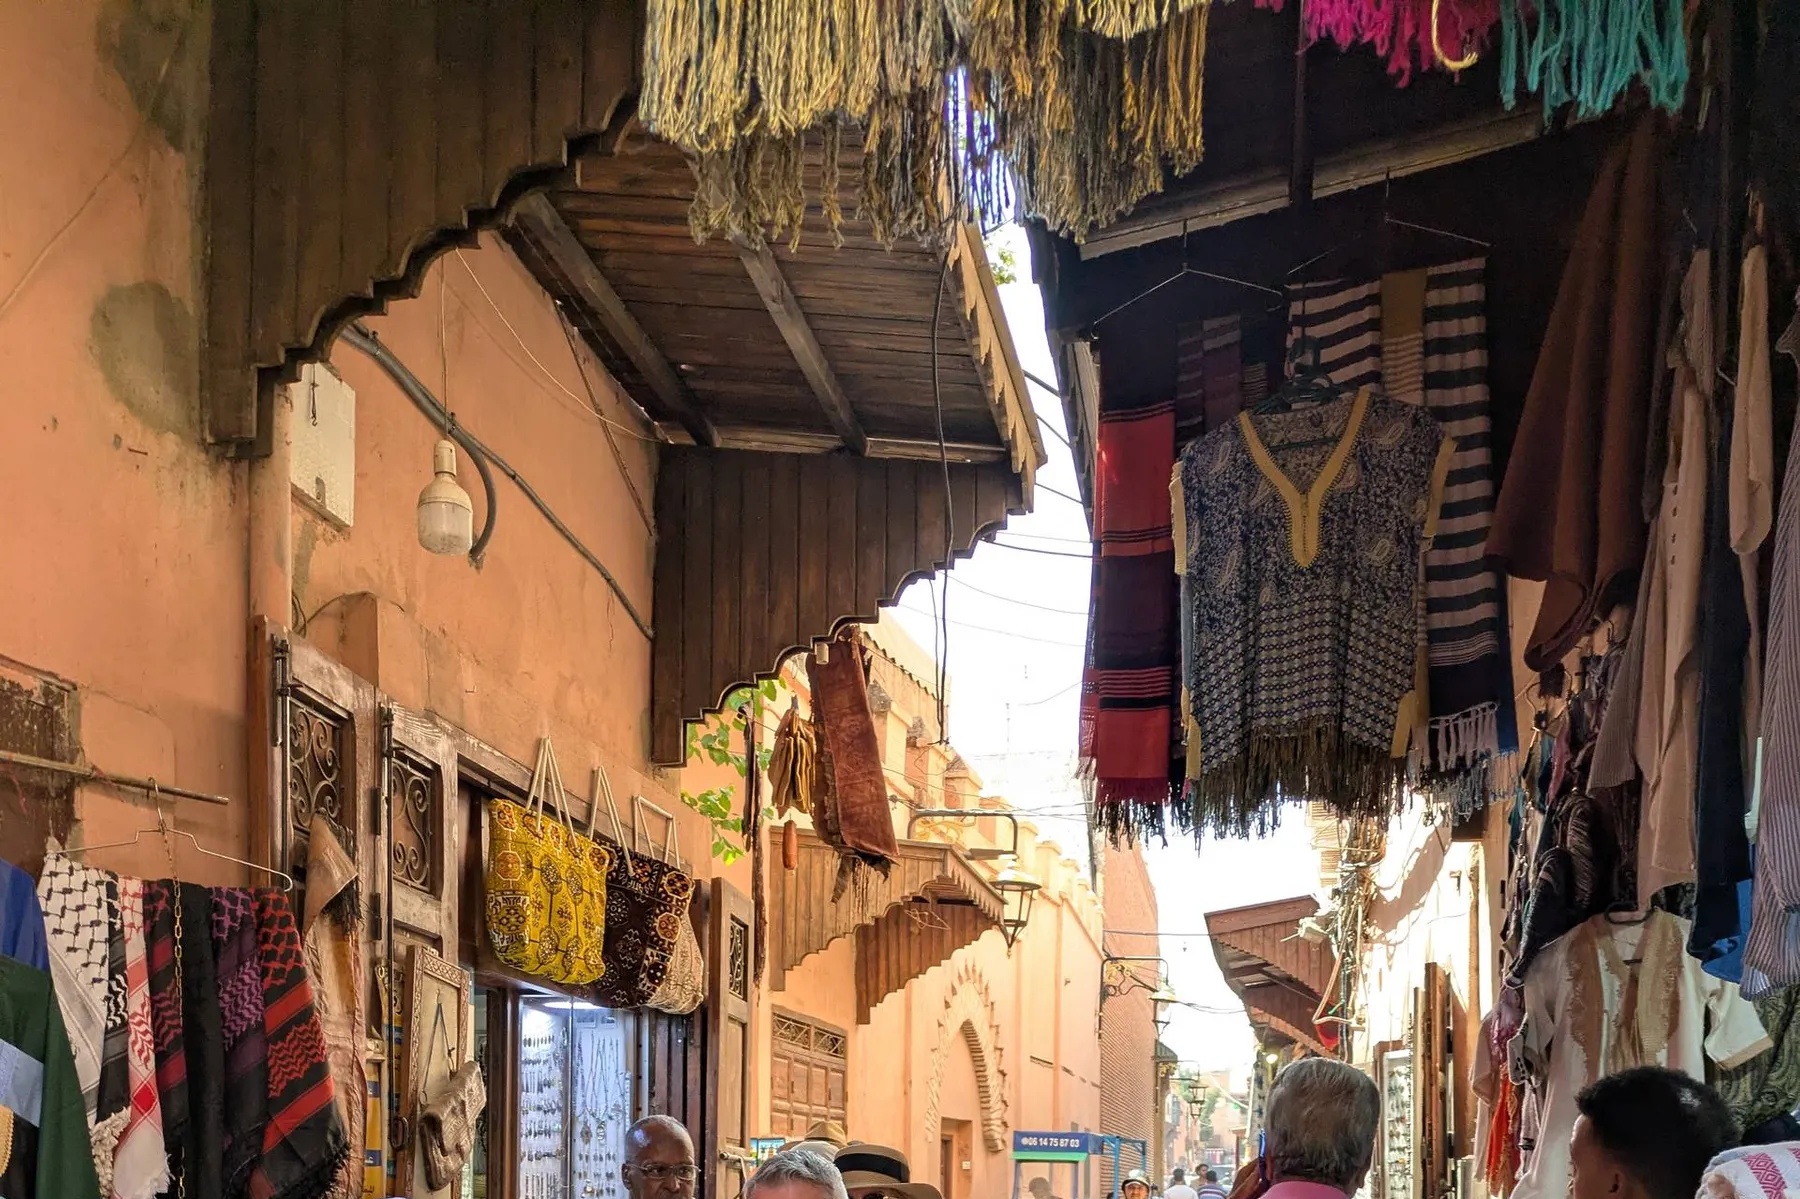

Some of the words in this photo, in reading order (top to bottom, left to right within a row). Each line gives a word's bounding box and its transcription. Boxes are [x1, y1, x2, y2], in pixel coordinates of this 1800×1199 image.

[1039, 1137, 1048, 1146] 14
[1049, 1138, 1058, 1147] 75
[1059, 1138, 1069, 1147] 87
[1070, 1138, 1080, 1148] 03
